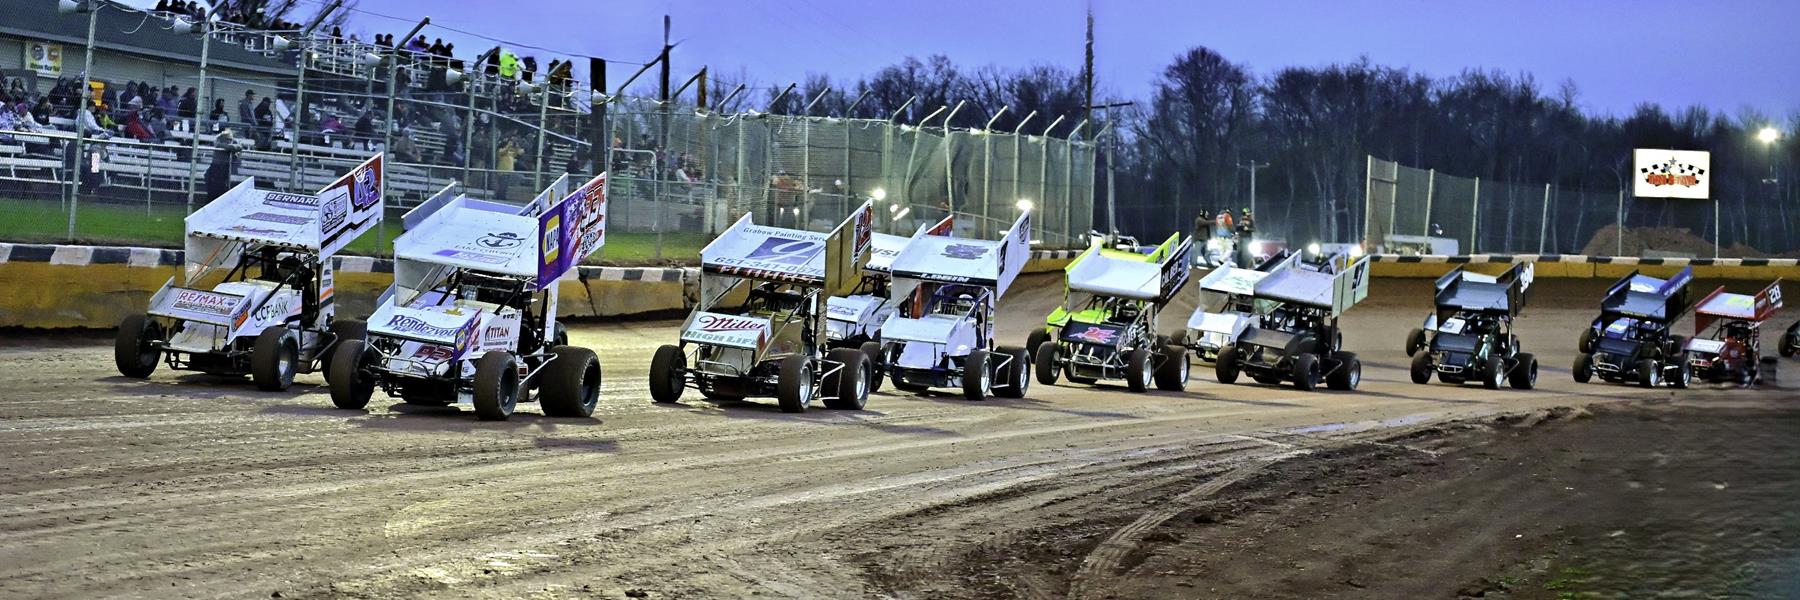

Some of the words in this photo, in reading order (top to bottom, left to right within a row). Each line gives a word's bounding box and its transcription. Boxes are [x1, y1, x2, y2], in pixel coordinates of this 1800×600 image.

[743, 227, 772, 236] Grabow
[774, 231, 807, 240] Painting
[179, 291, 226, 306] RE/MAX
[1768, 284, 1781, 304] 28
[699, 315, 766, 329] Miller
[490, 326, 510, 339] TITAN
[685, 330, 725, 341] HIGH
